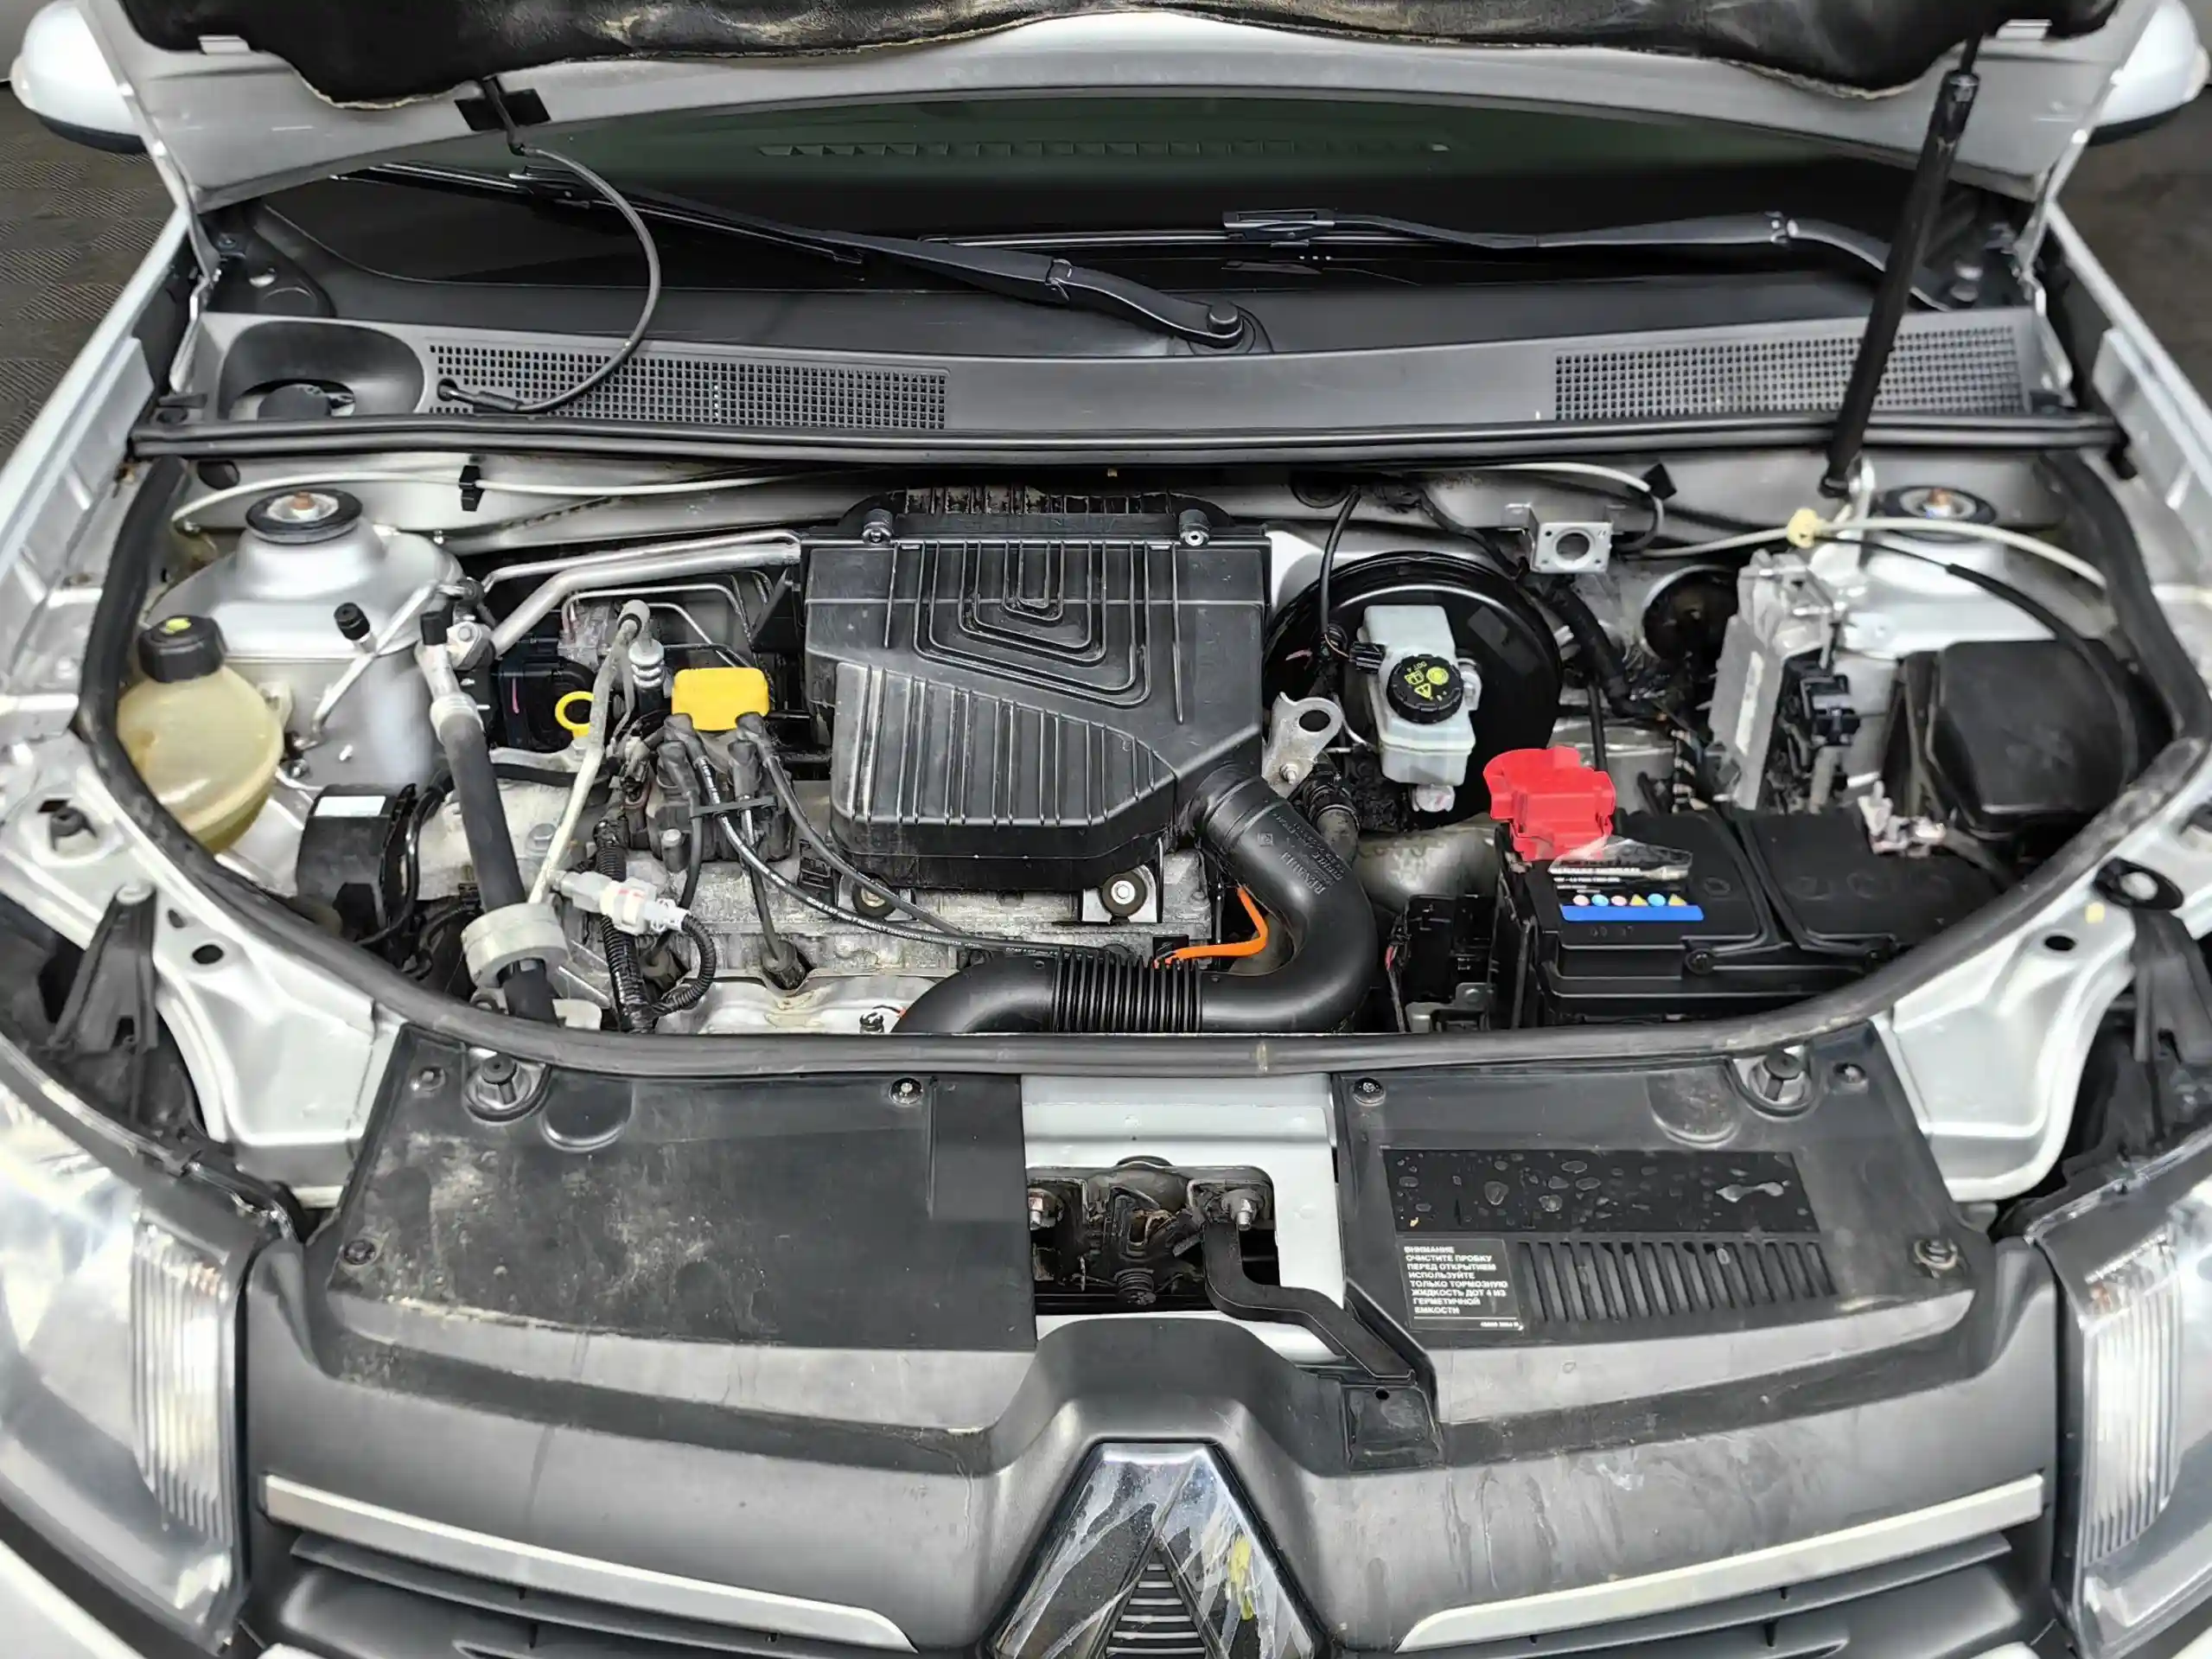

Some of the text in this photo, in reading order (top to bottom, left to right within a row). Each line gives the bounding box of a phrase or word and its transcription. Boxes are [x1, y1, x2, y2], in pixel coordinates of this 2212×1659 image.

[1408, 1271, 1476, 1279] ИСПОЛЬЗУЙТЕ
[1465, 1289, 1484, 1298] ДОТ
[1412, 1297, 1481, 1305] ГЕРМЕТИЧНОЙ
